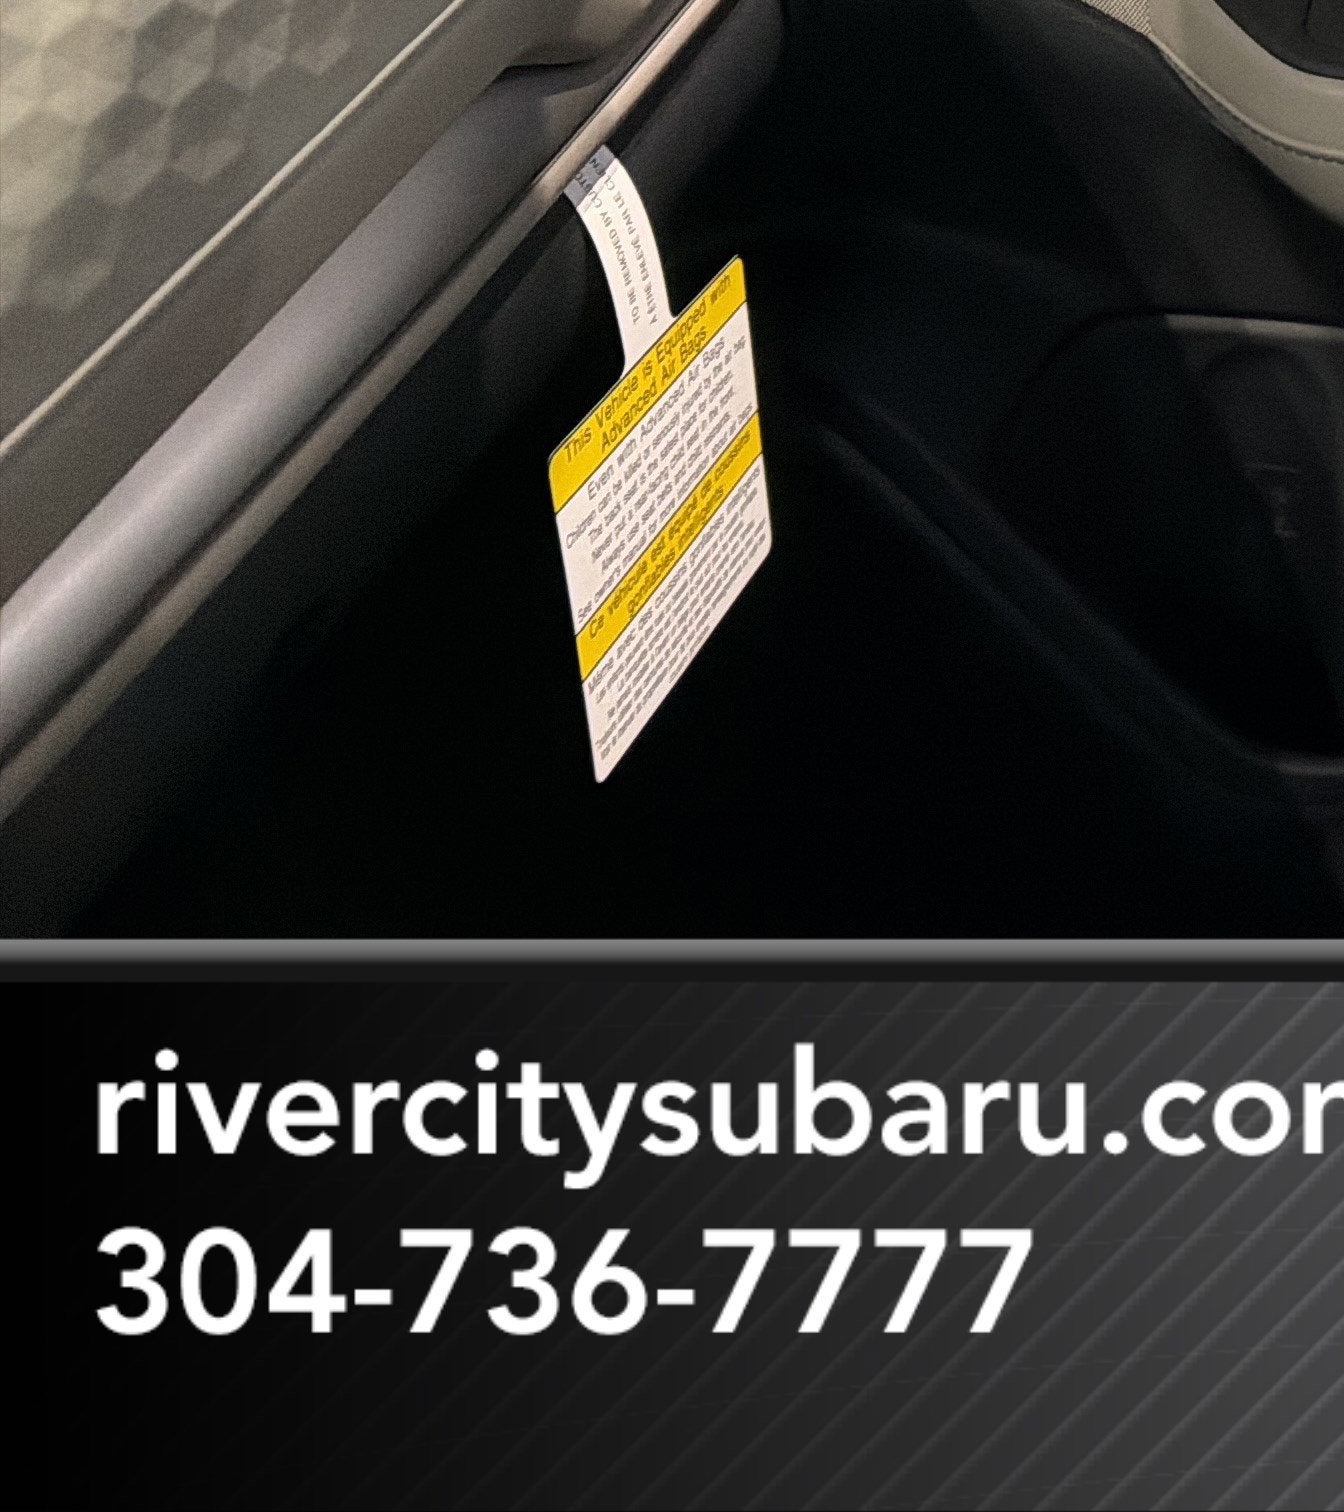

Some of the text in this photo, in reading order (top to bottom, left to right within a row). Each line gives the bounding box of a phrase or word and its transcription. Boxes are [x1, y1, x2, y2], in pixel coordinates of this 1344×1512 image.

[608, 228, 634, 288] REMOVED
[564, 427, 591, 462] This
[595, 375, 638, 428] Vehicle
[642, 359, 652, 379] is
[655, 299, 706, 363] Equipped
[587, 336, 724, 500] Even with Advanced Air Bags
[601, 325, 706, 452] Advanced Air Bags
